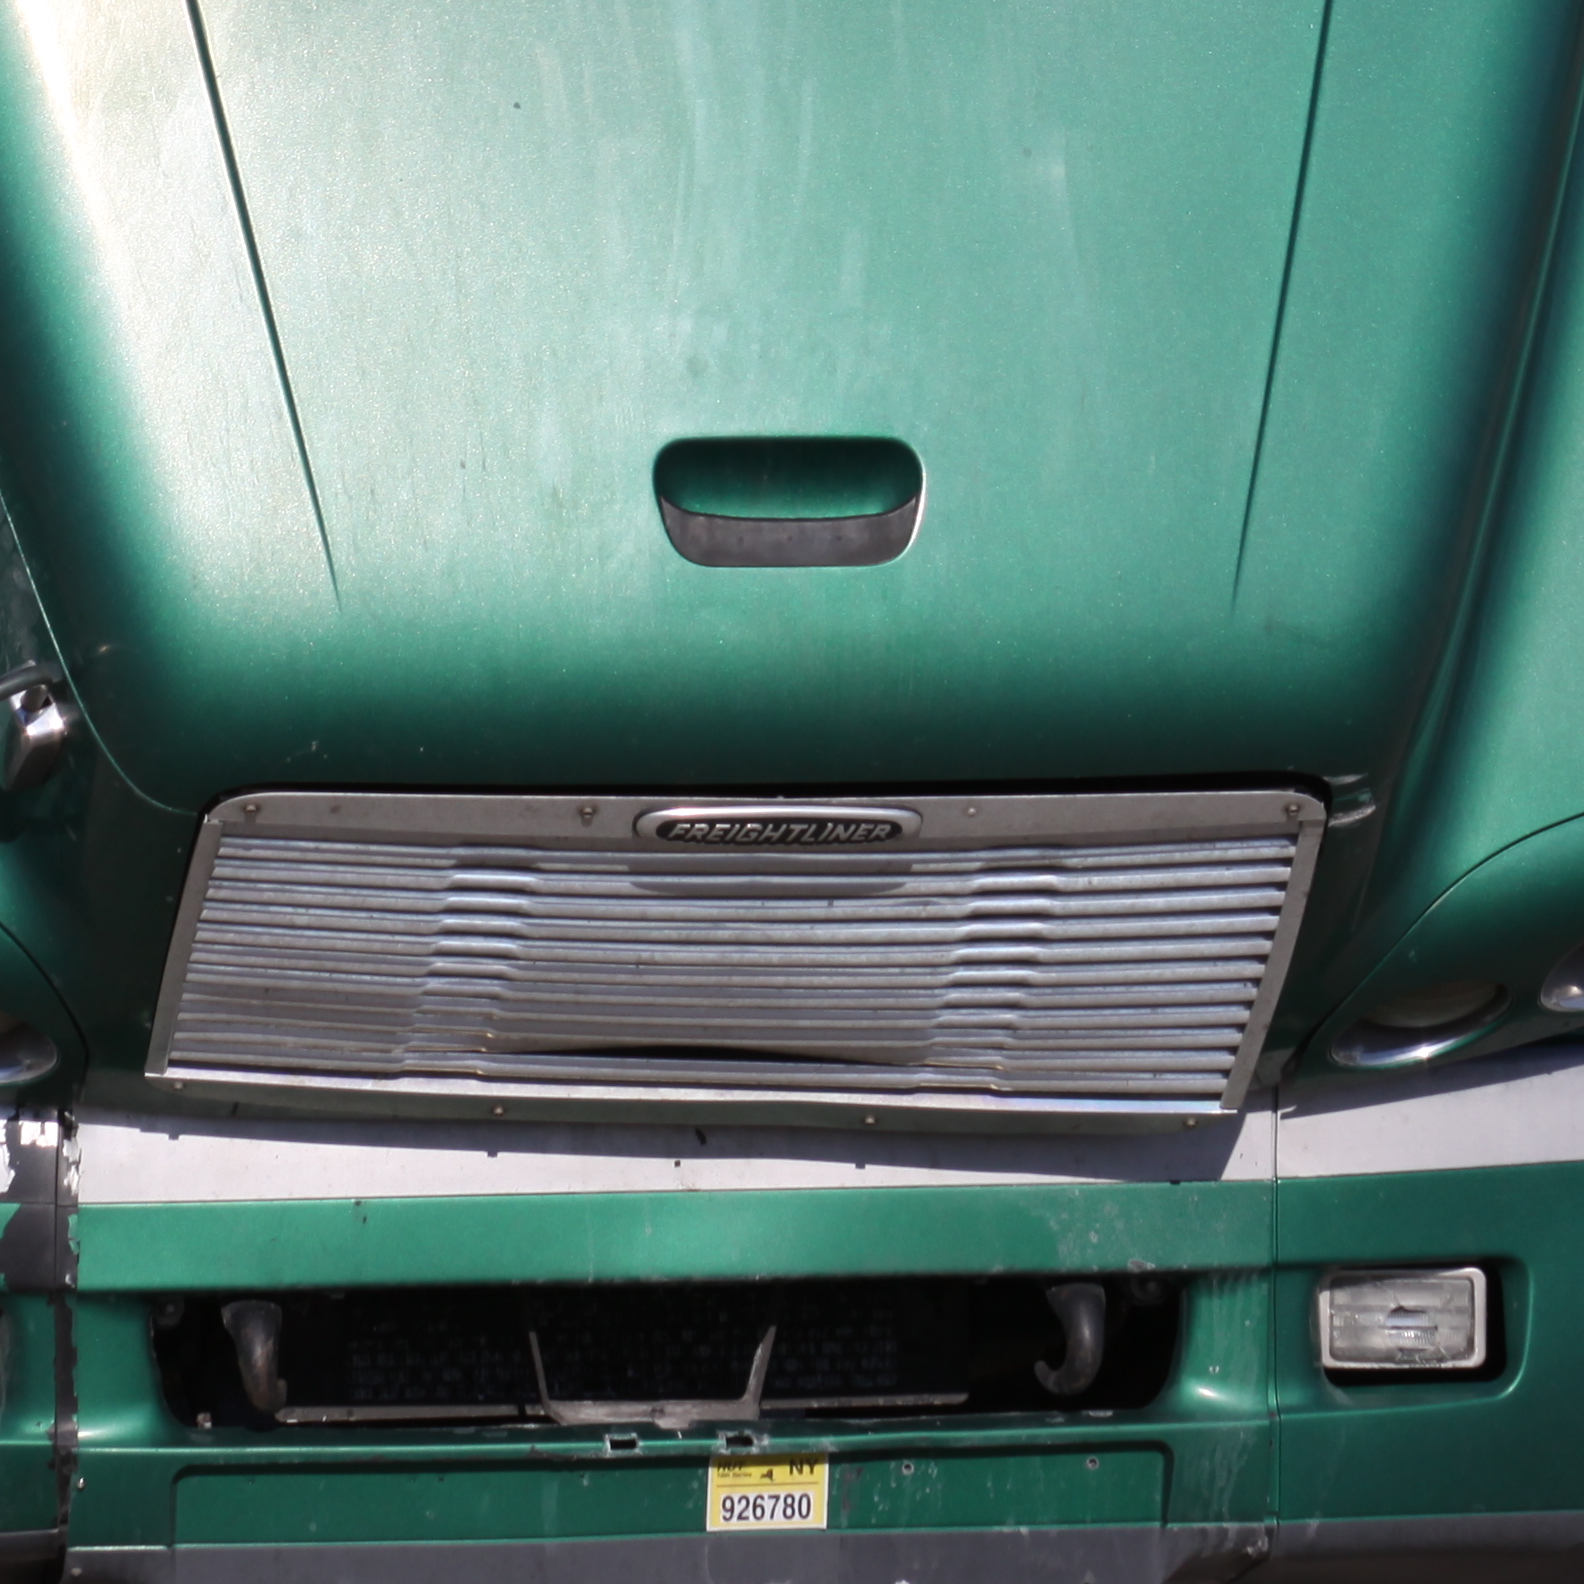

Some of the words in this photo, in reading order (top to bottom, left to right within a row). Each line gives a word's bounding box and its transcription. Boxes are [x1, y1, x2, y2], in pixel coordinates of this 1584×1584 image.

[667, 822, 893, 844] FREIGHTLINER
[789, 1458, 819, 1475] NY
[722, 1493, 812, 1522] 926780
